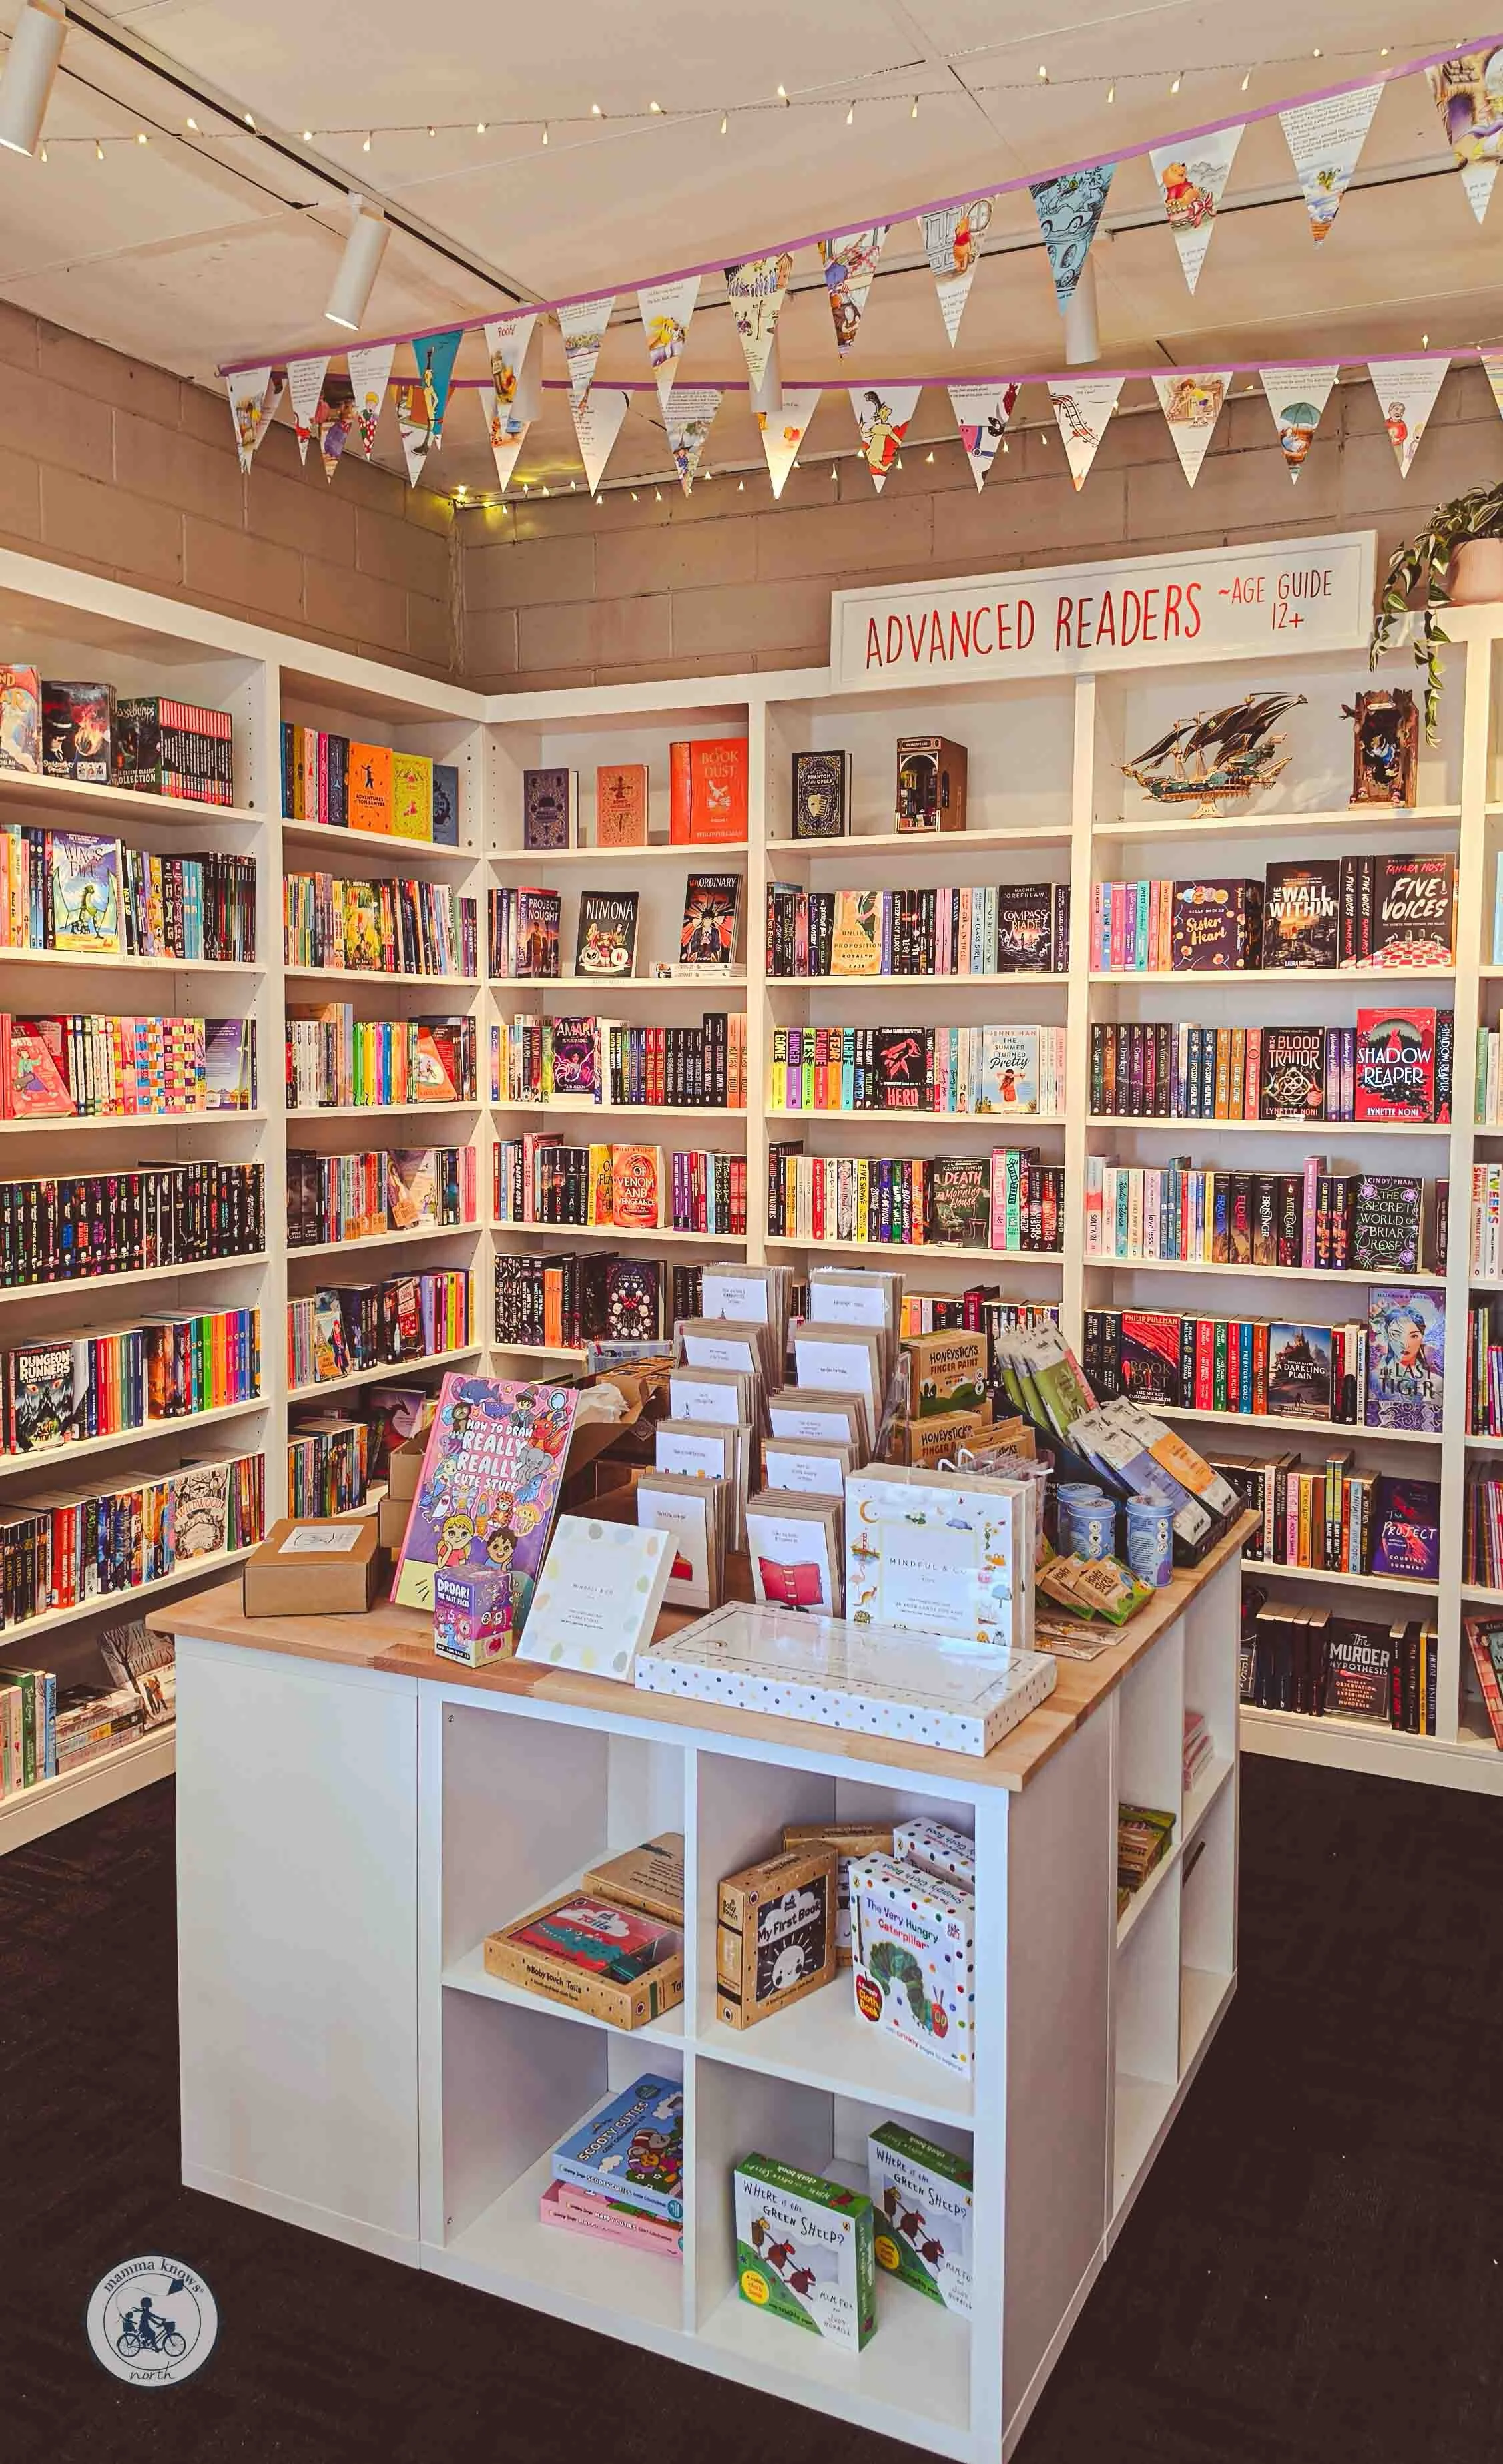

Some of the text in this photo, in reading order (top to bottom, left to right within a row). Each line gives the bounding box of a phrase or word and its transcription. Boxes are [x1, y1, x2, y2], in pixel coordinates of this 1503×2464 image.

[866, 569, 1333, 670] ADVANCED READERS GUIDE
[1271, 603, 1304, 630] 12+
[701, 751, 739, 764] BOOK
[704, 764, 737, 778] DUST
[63, 844, 103, 862] WINGS
[1273, 887, 1281, 903] THE
[1283, 886, 1331, 903] WALL
[1362, 875, 1370, 916] FIVE VOICES
[1392, 877, 1440, 897] FIVE
[529, 897, 558, 910] PROJECT
[586, 899, 633, 921] NIMONA
[1269, 901, 1334, 918] WITHIN
[1382, 899, 1447, 921] VOICES
[528, 910, 559, 922] NOUGHT
[1004, 909, 1047, 921] COMPASS
[1186, 916, 1223, 933] Sister
[894, 926, 900, 934] OF
[1191, 929, 1227, 946] Heart
[557, 1022, 593, 1037] AMARI
[774, 1034, 786, 1059] GONE
[789, 1033, 800, 1064] HUNGER
[803, 1039, 814, 1058] LIES
[816, 1031, 827, 1065] PLAGUE
[829, 1037, 840, 1059] FEAR
[844, 1036, 854, 1062] LIGHT
[1277, 1036, 1319, 1049] BLOOD
[728, 1046, 737, 1067] GAMES
[990, 1056, 1030, 1069] Pretty
[1269, 1049, 1319, 1069] TRAITOR
[1357, 1048, 1432, 1064] SHADOW
[1438, 1027, 1450, 1091] SHADOW REAPER
[854, 1068, 864, 1099] MONSTER
[1364, 1067, 1423, 1088] REAPER
[886, 1087, 918, 1106] HERO
[1367, 1107, 1420, 1116] LYNETTE NONI
[633, 1166, 647, 1176] OF
[769, 1153, 777, 1177] MORBID
[617, 1177, 655, 1188] VENOM
[944, 1171, 982, 1184] DEATH
[1392, 1178, 1414, 1186] PHAM
[1473, 1167, 1481, 1204] SMART
[625, 1187, 647, 1197] AND
[902, 1189, 910, 1203] BOX
[945, 1186, 982, 1199] Morning
[1380, 1190, 1399, 1200] THE
[1488, 1169, 1500, 1224] TWEENS
[618, 1198, 656, 1206] VENGEANCE
[893, 1186, 901, 1226] HAND WALL
[950, 1197, 976, 1207] House
[1365, 1201, 1413, 1213] SECRET
[1260, 1196, 1272, 1239] BRISINGR
[1283, 1196, 1296, 1238] MURTAGH
[1360, 1212, 1403, 1226] WORLD
[1147, 1214, 1157, 1244] loveless
[1369, 1227, 1404, 1238] BRIAR
[1370, 1239, 1402, 1250] ROSE
[1125, 1315, 1178, 1325] PHILIP PULLMAN
[19, 1350, 70, 1369] DUNGEON
[930, 1344, 978, 1364] HONEYSTICKS
[19, 1361, 70, 1381] RUNNERS
[930, 1358, 978, 1374] FINGER PAINT
[1283, 1364, 1325, 1375] DARKLING
[1289, 1371, 1313, 1379] PLAIN
[1394, 1364, 1433, 1380] LAST
[1380, 1379, 1436, 1399] TIGER
[467, 1419, 533, 1438] HOW TO DRAW
[462, 1431, 527, 1458] REALLY
[922, 1443, 950, 1457] FINGER
[457, 1451, 522, 1479] REALLY
[454, 1473, 517, 1493] CUTE STUFF
[1382, 1521, 1437, 1540] PROJECT
[890, 1558, 938, 1571] MINDFUL
[437, 1578, 470, 1601] DROAR!
[1351, 1633, 1370, 1646] The
[1329, 1643, 1390, 1668] MURDER
[1329, 1661, 1388, 1676] HYPOTHESIS
[758, 1902, 821, 1941] My First Book
[866, 1897, 939, 1945] The Very Hungry
[878, 1919, 929, 1949] Caterpillar
[531, 1966, 582, 1993] Baby Touch Tails
[578, 2101, 649, 2160] SCOOTY CUTIES
[894, 2173, 967, 2218] GREEN SHEEP?
[762, 2206, 845, 2247] GREEN SHEEP?
